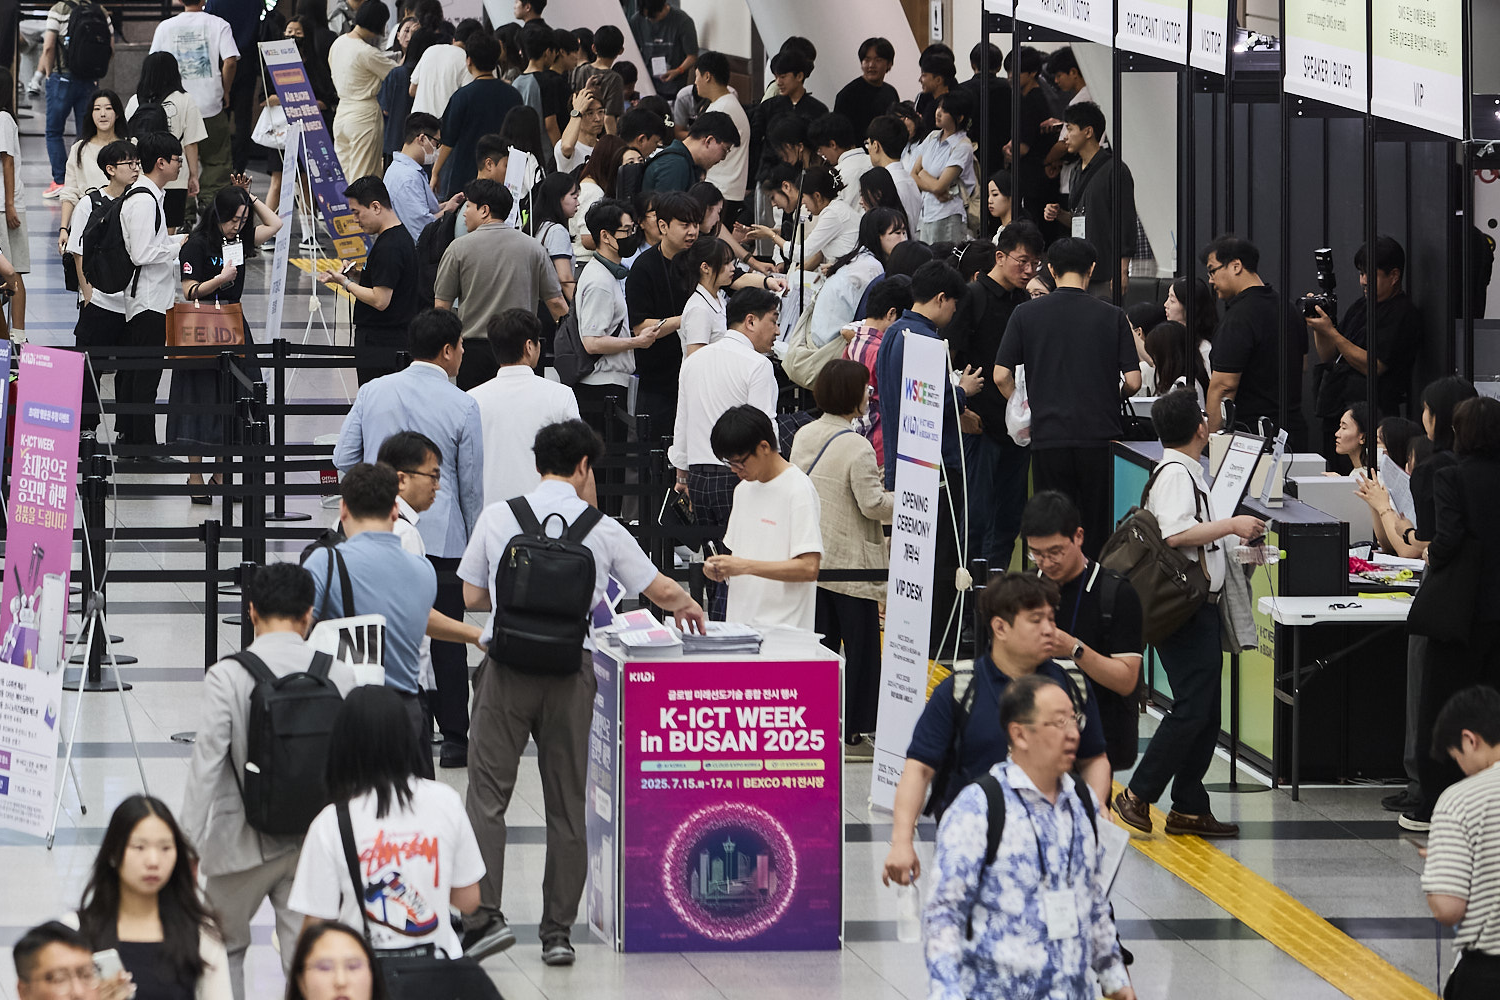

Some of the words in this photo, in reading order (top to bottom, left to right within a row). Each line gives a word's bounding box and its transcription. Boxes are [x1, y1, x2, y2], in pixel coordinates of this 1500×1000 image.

[1127, 12, 1158, 39] PARTICIPANT
[1162, 20, 1181, 45] VISITOR
[1201, 28, 1222, 55] VISITOR
[1303, 55, 1329, 84] SPEAKER
[1333, 61, 1353, 90] BUYER
[1413, 81, 1424, 108] VIP
[20, 433, 38, 449] K-ICT
[37, 436, 55, 452] WEEK
[21, 453, 68, 484] 초대장으로
[17, 477, 46, 506] 응모만
[48, 484, 67, 511] 하면
[901, 490, 929, 513] OPENING
[14, 503, 35, 526] 경품을
[37, 508, 68, 532] 드립니다!
[897, 513, 931, 539] CEREMONY
[903, 542, 920, 565] 개막식
[895, 577, 906, 596] VIP
[906, 581, 923, 602] DESK
[667, 689, 693, 701] 글로벌
[694, 688, 744, 701] 미래선도기술
[744, 688, 761, 700] 종합
[762, 688, 779, 700] 전시
[780, 688, 798, 700] 행사
[660, 706, 731, 729] K-ICT
[735, 706, 807, 728] WEEK
[640, 730, 663, 752] in
[668, 730, 758, 752] BUSAN
[763, 729, 825, 751] 2025
[641, 778, 671, 790] 2025.
[742, 777, 780, 788] BEXCO
[781, 776, 825, 788] 제1전시장
